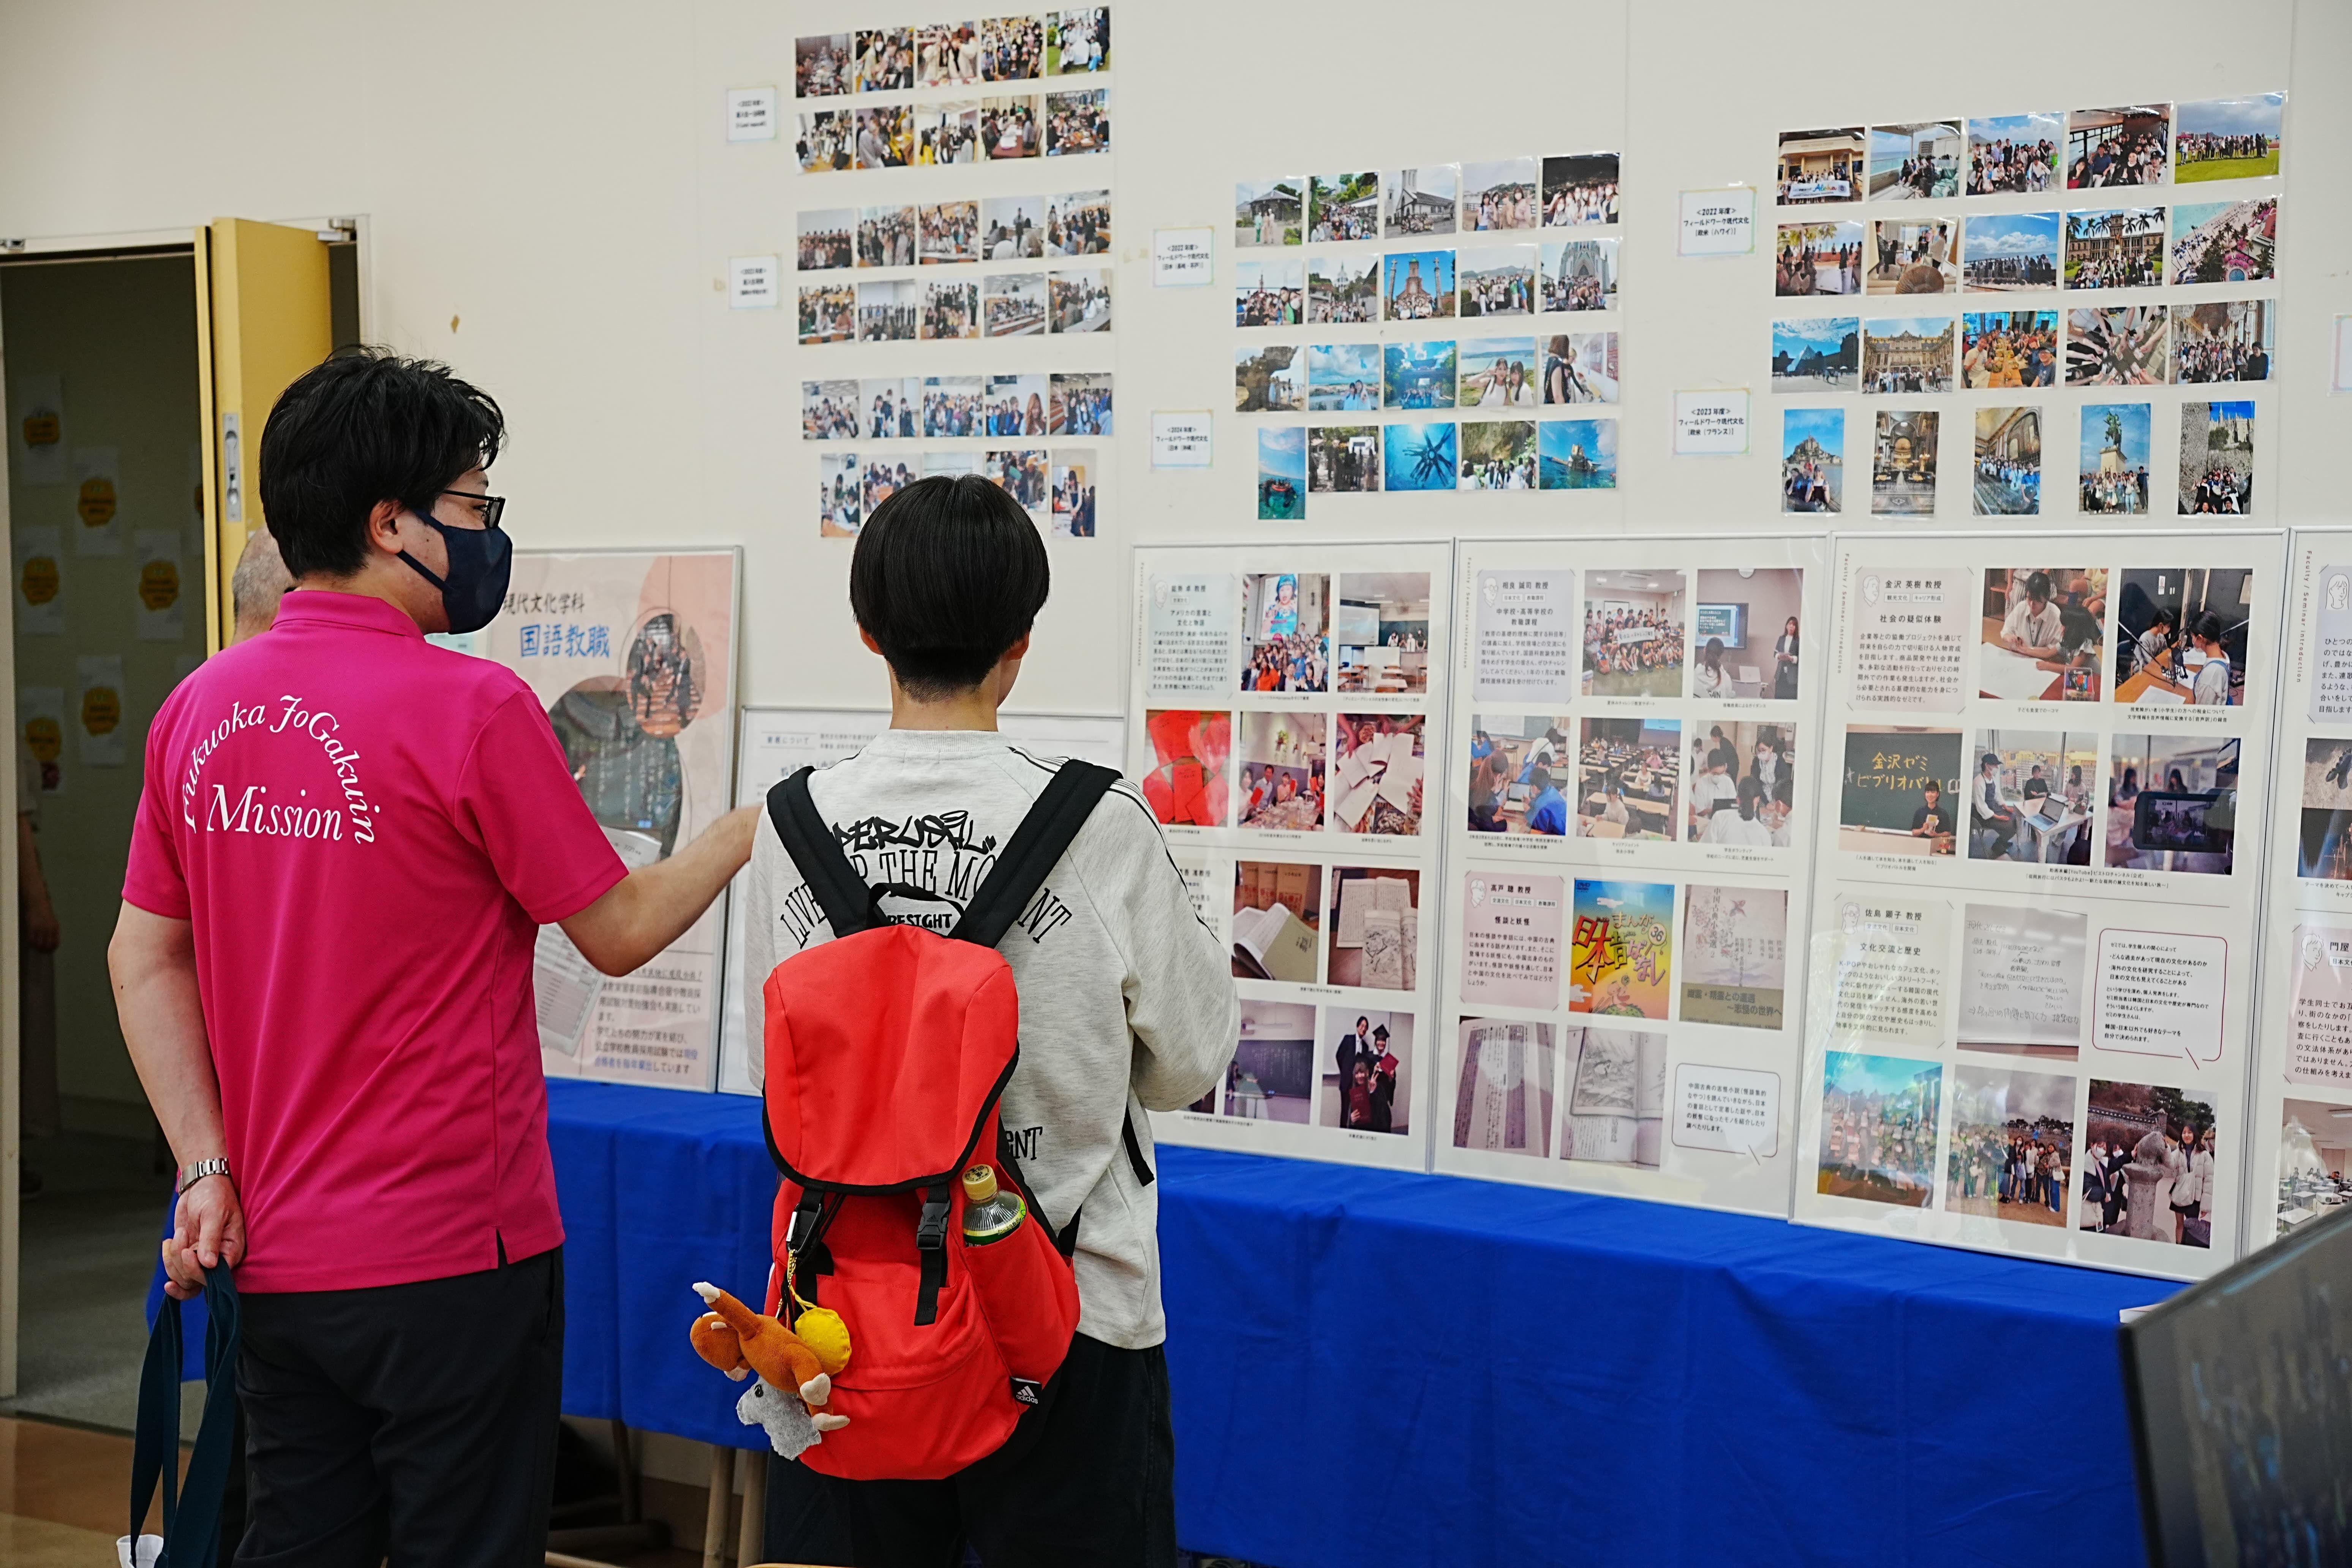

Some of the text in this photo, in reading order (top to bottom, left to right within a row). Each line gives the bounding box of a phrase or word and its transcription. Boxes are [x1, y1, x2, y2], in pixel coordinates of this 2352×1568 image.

[2303, 551, 2312, 582] Faculty
[1885, 580, 1902, 589] 金沢
[1925, 580, 1942, 589] 教授
[1880, 615, 1942, 623] 社会の疑似体験
[520, 623, 610, 658] 国語教職
[2297, 630, 2305, 683] introduction
[1872, 751, 1929, 771] 金沢ゼミ
[269, 695, 380, 844] JoGakuin
[207, 784, 342, 841] Mission
[879, 849, 938, 894] THE
[1517, 886, 1531, 894] 教授
[1495, 916, 1530, 926] 怪談と妖怪
[1612, 911, 1655, 929] まんが
[1865, 909, 1881, 918] 佐島
[1906, 912, 1922, 921] 教授
[1651, 926, 1664, 941] 36
[1860, 943, 1921, 956] 文化交流と歴史
[2330, 942, 2349, 952] 門屋
[2297, 1032, 2352, 1044] 査に行くこともあ
[2295, 1067, 2352, 1078] の仕組みを考えま
[1016, 1395, 1038, 1404] adidas
